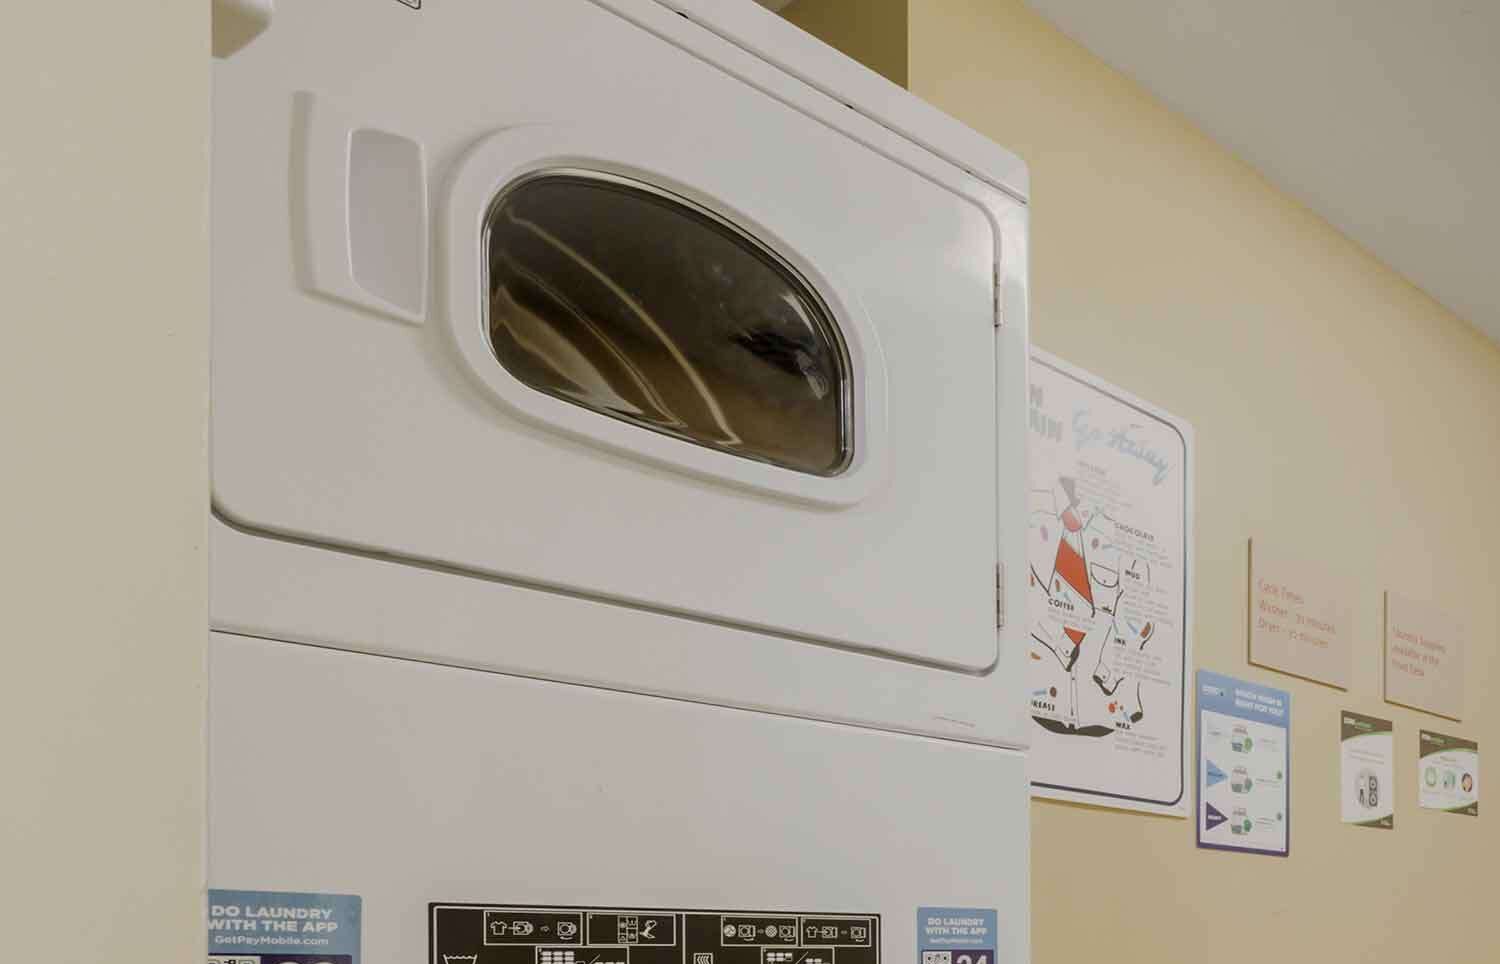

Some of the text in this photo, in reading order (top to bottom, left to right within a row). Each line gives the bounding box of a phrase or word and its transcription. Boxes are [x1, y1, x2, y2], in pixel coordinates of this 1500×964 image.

[1030, 699, 1055, 712] REASE
[211, 905, 333, 920] DO LAUNDRY
[207, 919, 338, 933] WITH THE APP
[215, 935, 329, 946] GetPayMobile.com
